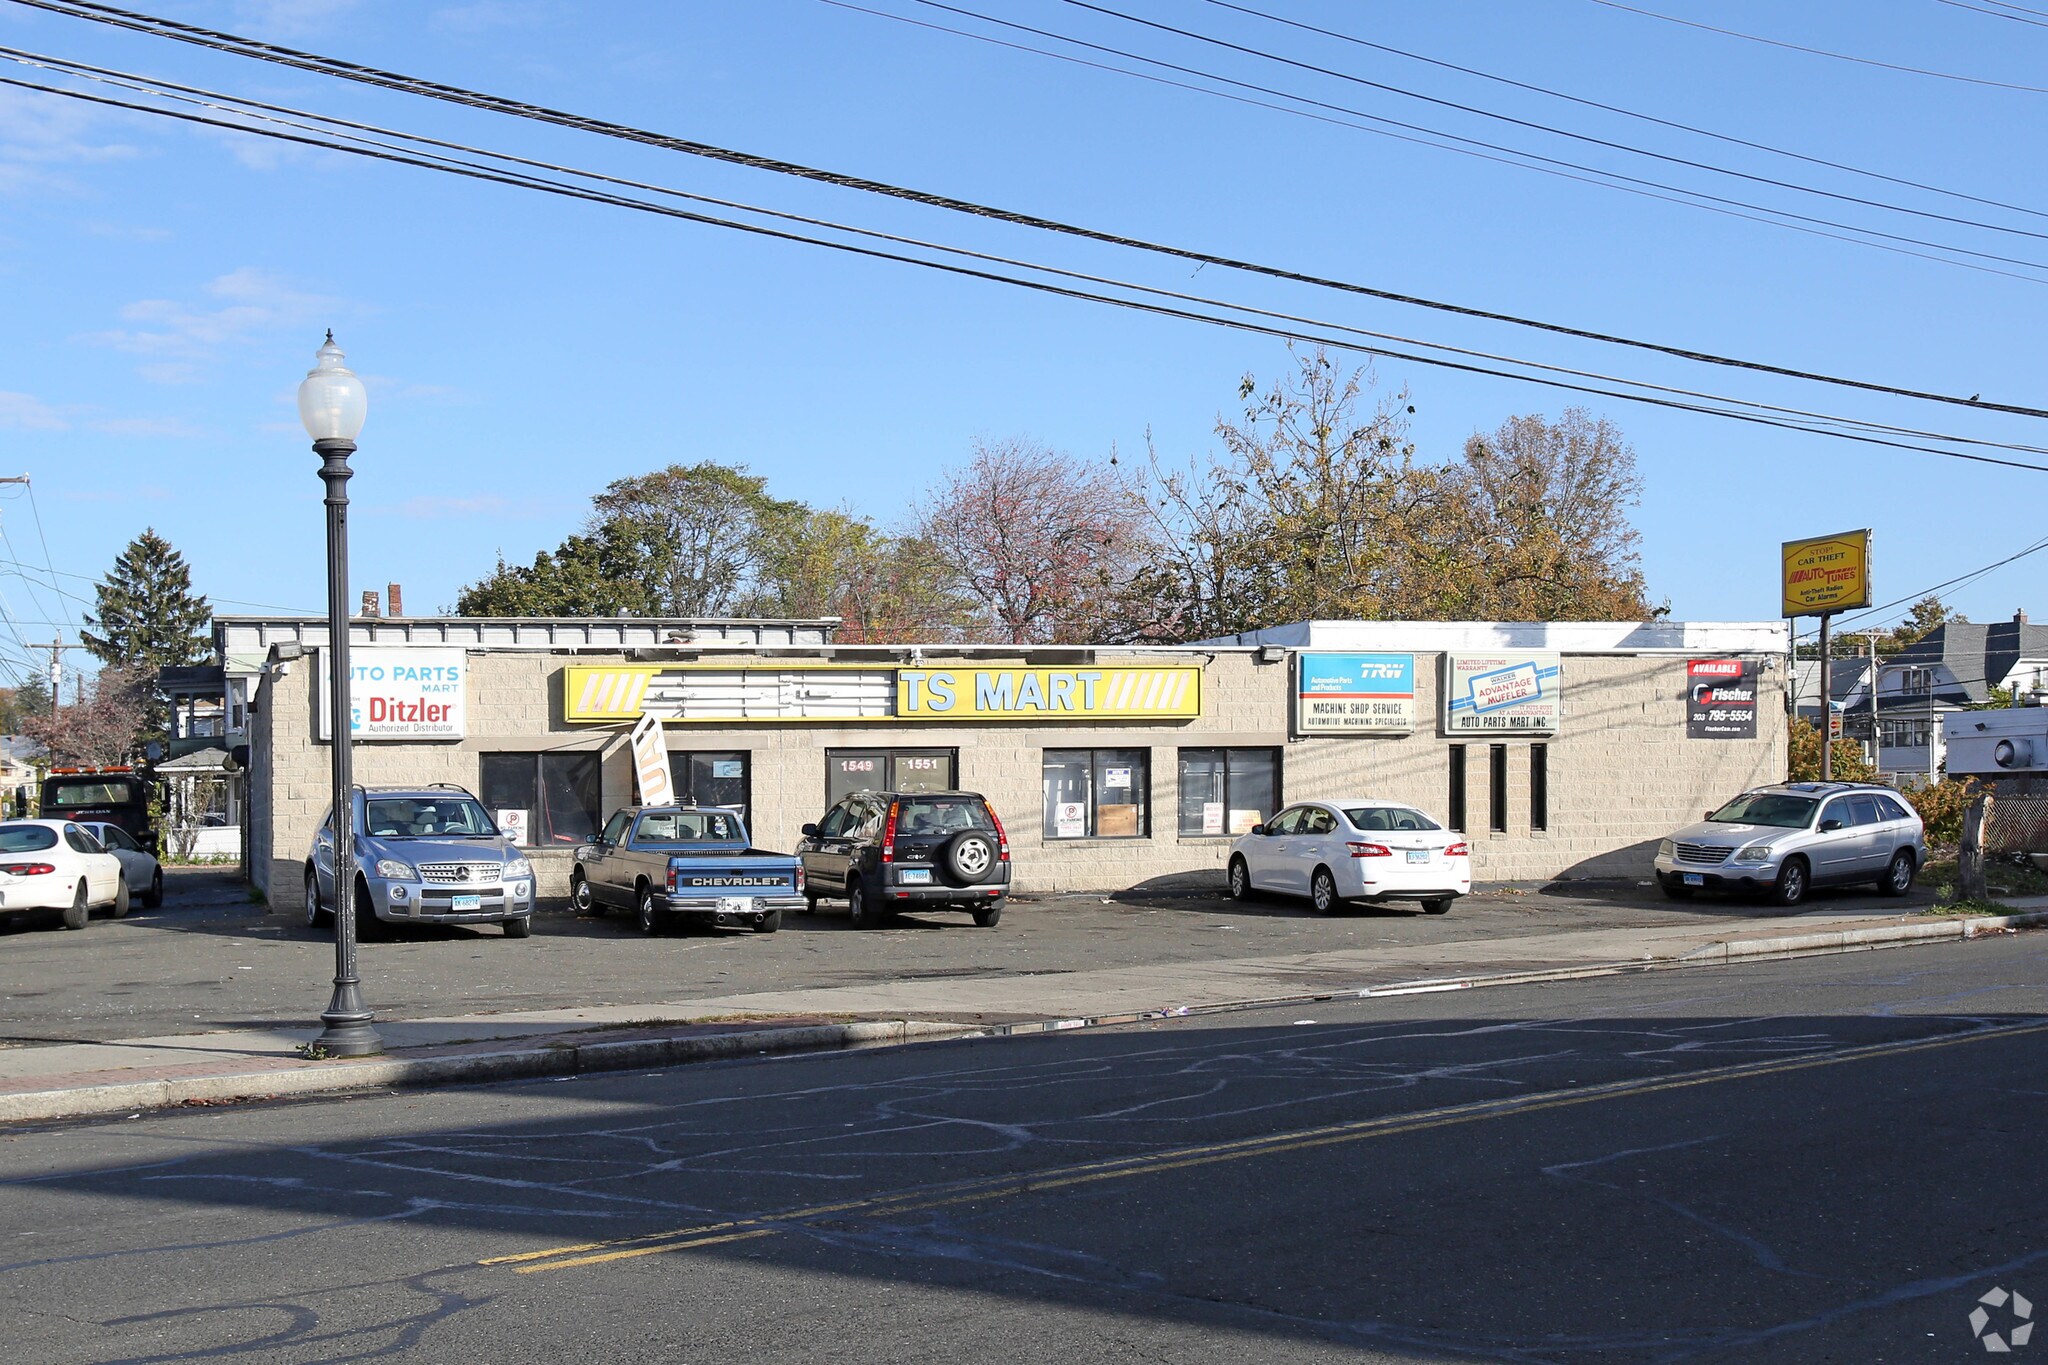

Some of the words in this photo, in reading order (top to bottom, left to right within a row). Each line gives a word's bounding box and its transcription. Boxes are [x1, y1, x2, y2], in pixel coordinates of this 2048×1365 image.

[1810, 546, 1833, 556] STOP!
[1797, 557, 1815, 566] CAR
[1818, 552, 1845, 562] THEFT
[1801, 567, 1826, 582] AUTO
[1824, 570, 1856, 585] TUNES
[393, 667, 459, 681] PARTS
[1361, 663, 1405, 678] TRW
[1693, 664, 1737, 673] AVAILABLE
[422, 684, 458, 692] MART
[900, 672, 956, 711] TS
[975, 672, 1102, 711] MART
[1479, 678, 1532, 697] ADVANTAGE
[1487, 689, 1527, 704] MUFFLER
[370, 697, 451, 722] Ditzler
[1313, 703, 1346, 714] MACHINE
[1350, 703, 1369, 714] SHOP
[1373, 703, 1402, 714] SERVICE
[1461, 716, 1479, 727] AUTO
[1483, 716, 1506, 727] PARTS
[1510, 716, 1529, 727] MART
[1533, 716, 1548, 727] INC.
[1692, 713, 1706, 721] 203
[1708, 710, 1753, 722] 795-5554
[369, 724, 409, 732] Authorized
[413, 723, 453, 732] Distributor
[841, 760, 873, 772] 1549
[907, 759, 938, 770] 1551
[692, 878, 780, 886] CHEVROLET
